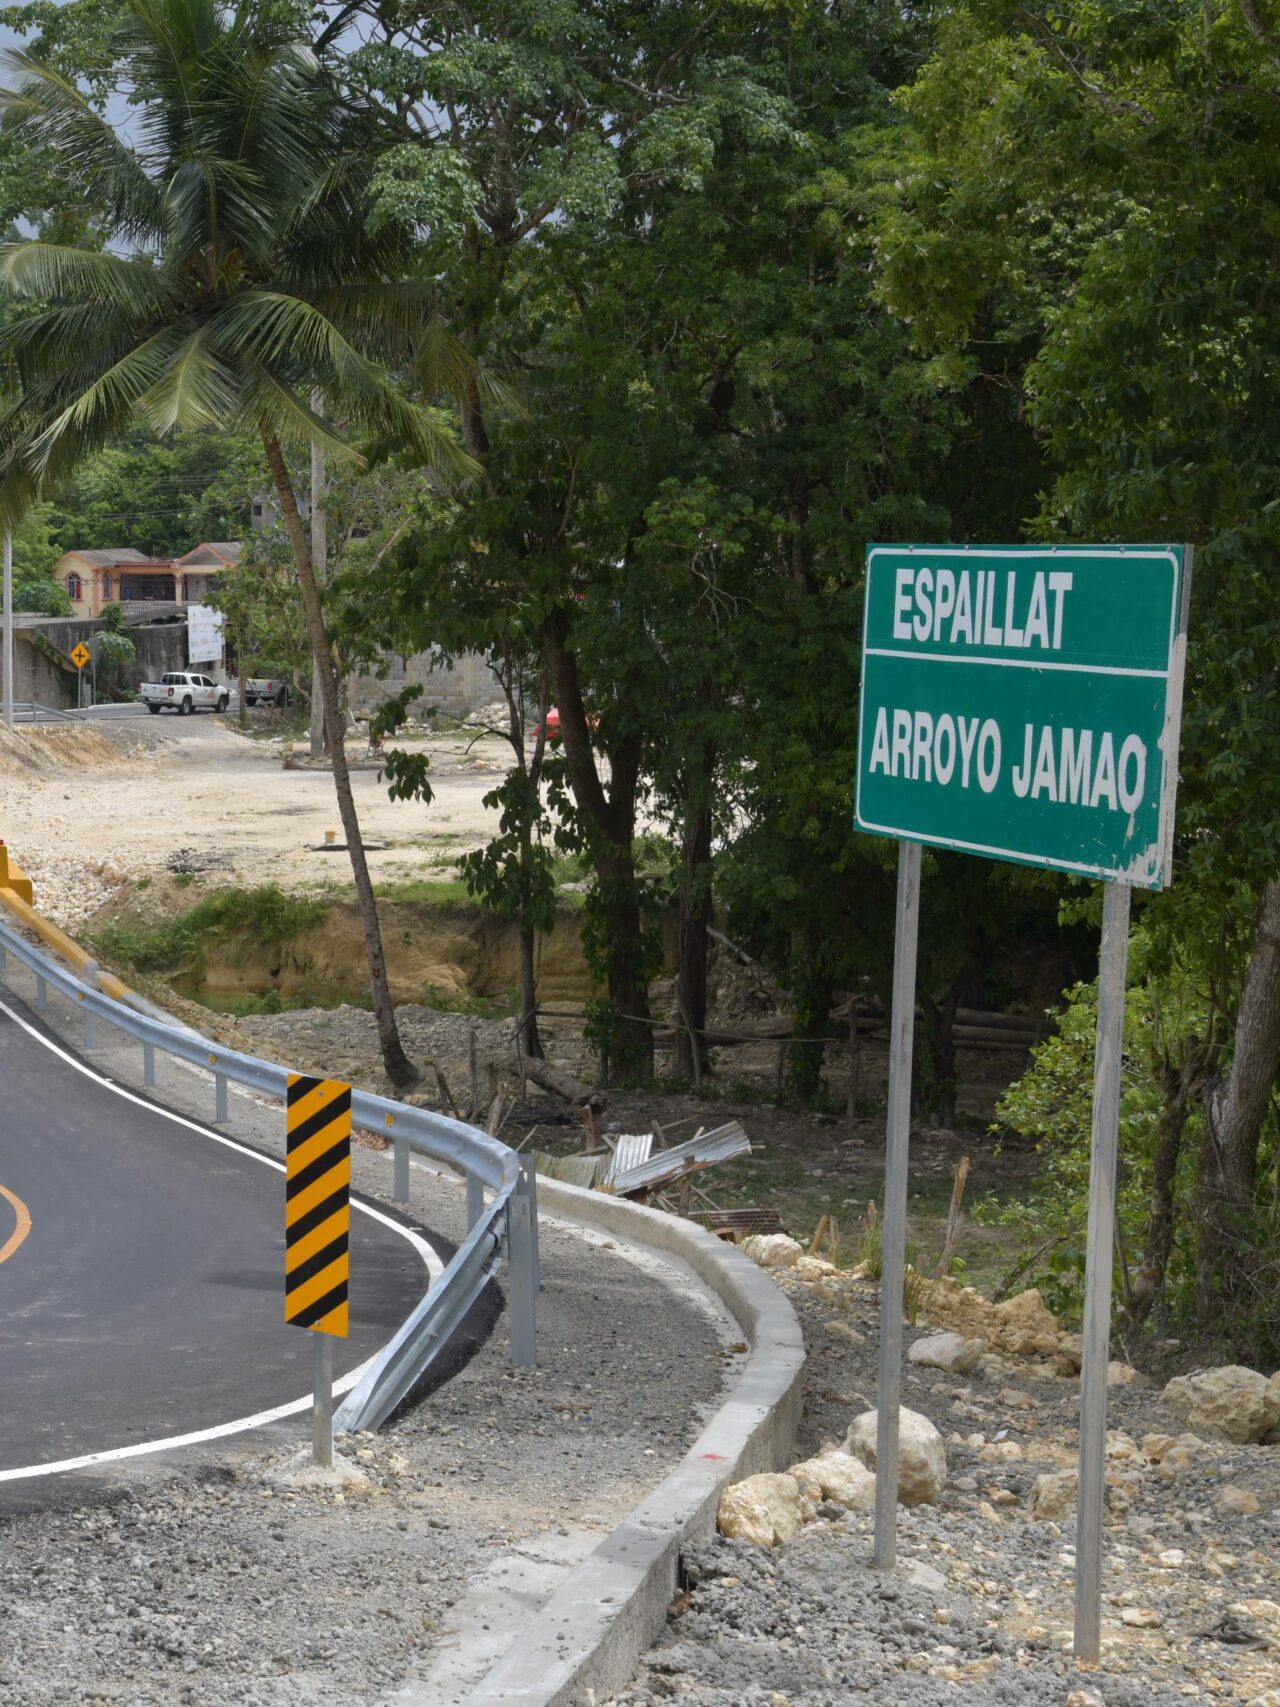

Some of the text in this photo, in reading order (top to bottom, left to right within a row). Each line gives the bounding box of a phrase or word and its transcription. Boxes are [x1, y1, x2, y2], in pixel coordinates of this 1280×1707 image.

[893, 568, 1073, 649] ESPAILLAT
[869, 707, 1147, 814] ARROYO JAMAO
